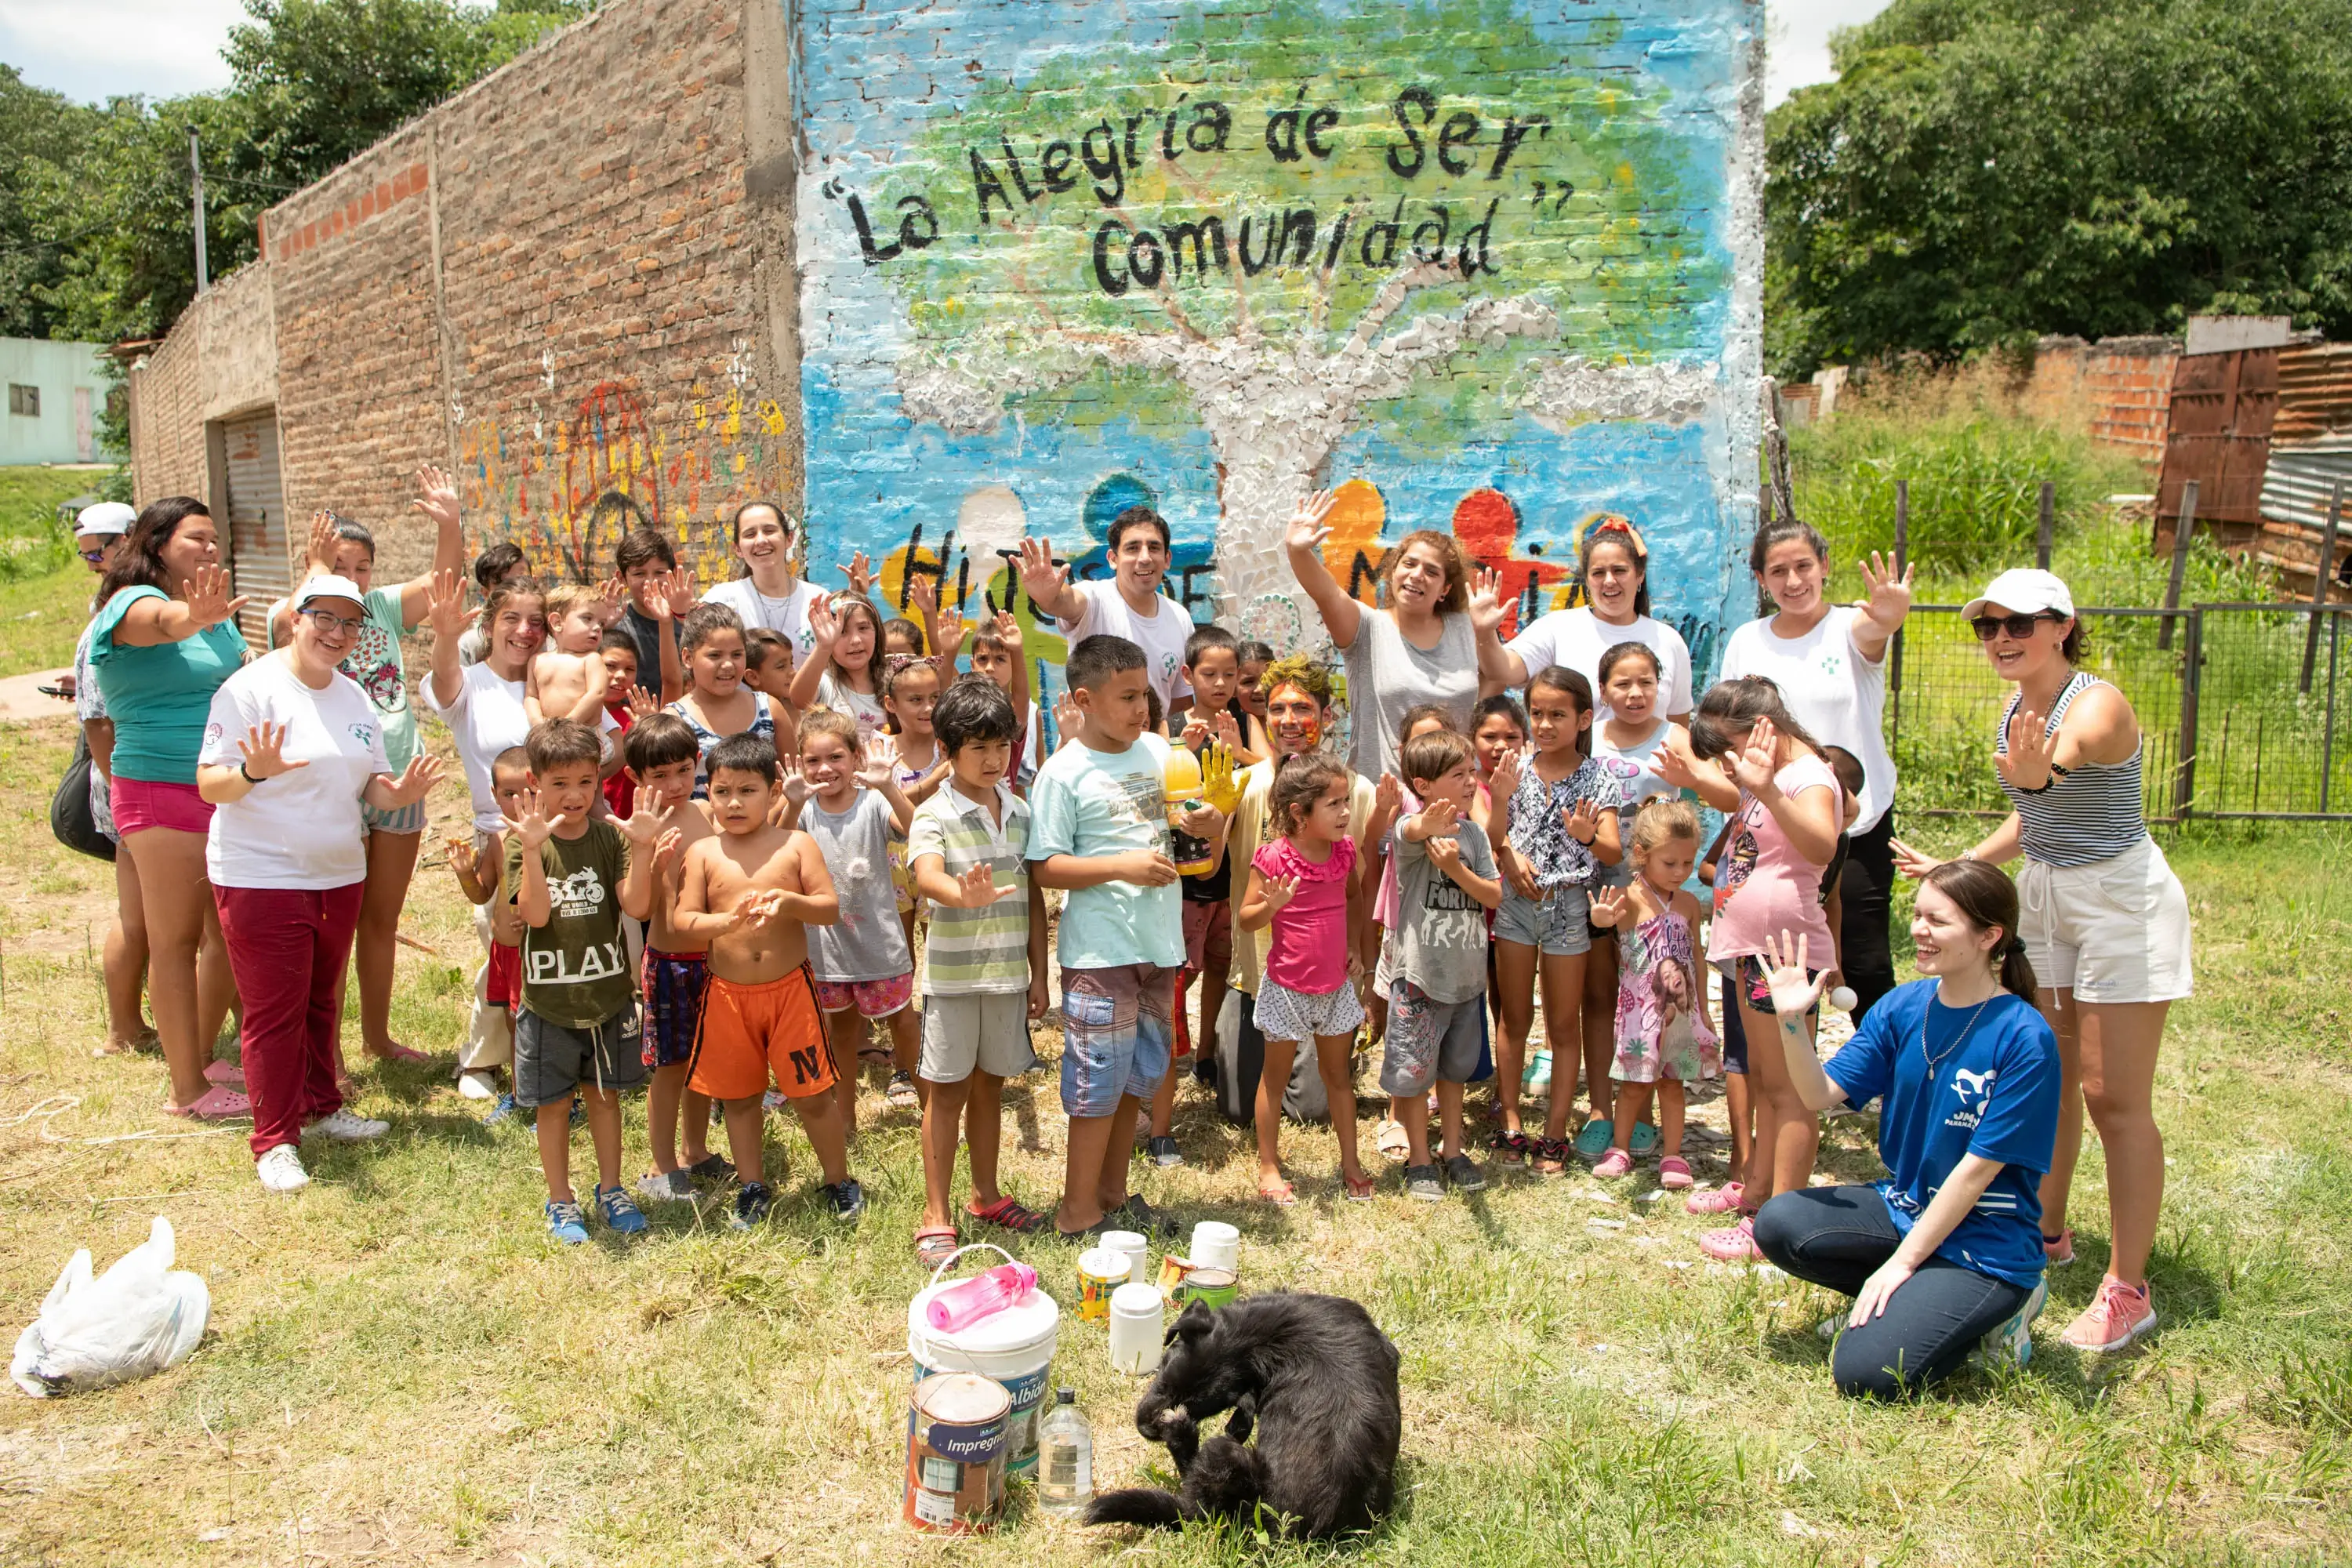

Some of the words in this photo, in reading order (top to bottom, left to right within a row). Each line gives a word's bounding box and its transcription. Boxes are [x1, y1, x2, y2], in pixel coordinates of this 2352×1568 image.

[1265, 82, 1341, 163] de
[1387, 85, 1552, 181] Ser
[530, 942, 625, 984] PLAY
[789, 1044, 820, 1084] N
[1011, 1380, 1046, 1406] Albión
